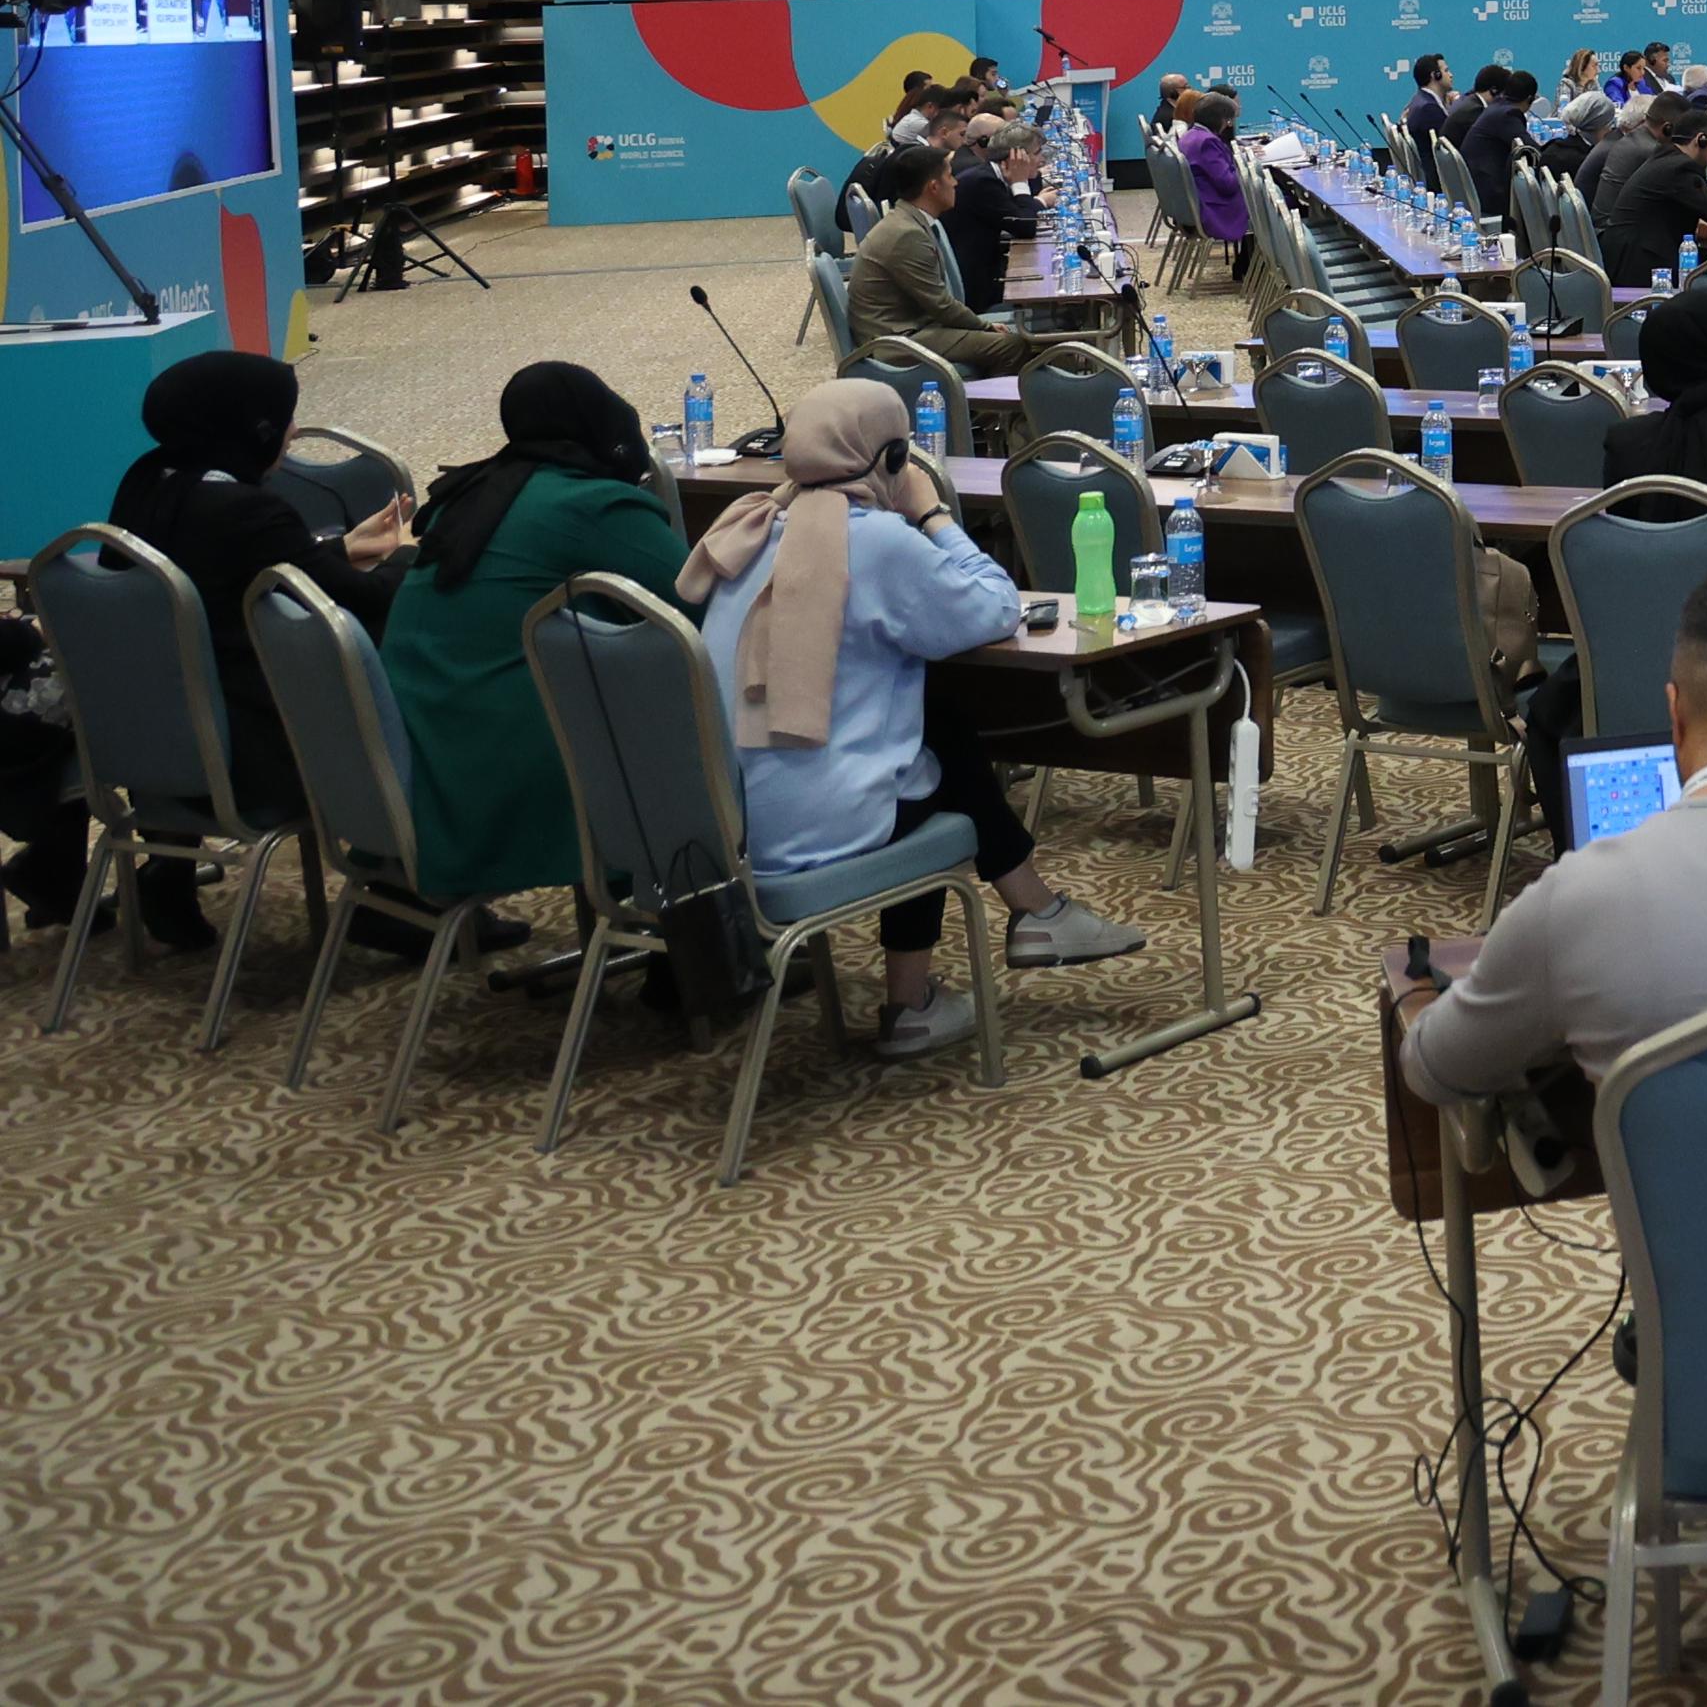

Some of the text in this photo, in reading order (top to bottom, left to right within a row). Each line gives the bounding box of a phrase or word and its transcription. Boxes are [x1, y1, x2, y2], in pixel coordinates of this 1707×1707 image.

[1318, 5, 1346, 15] UCLG
[1502, 0, 1530, 9] UCLG
[1681, 5, 1707, 15] CGLU
[1502, 10, 1530, 21] CGLU
[1318, 16, 1346, 27] CGLU
[1596, 52, 1621, 62] UCLG
[1226, 64, 1255, 75] UCLG
[1226, 76, 1255, 88] CGLU
[618, 132, 657, 147] UCLG
